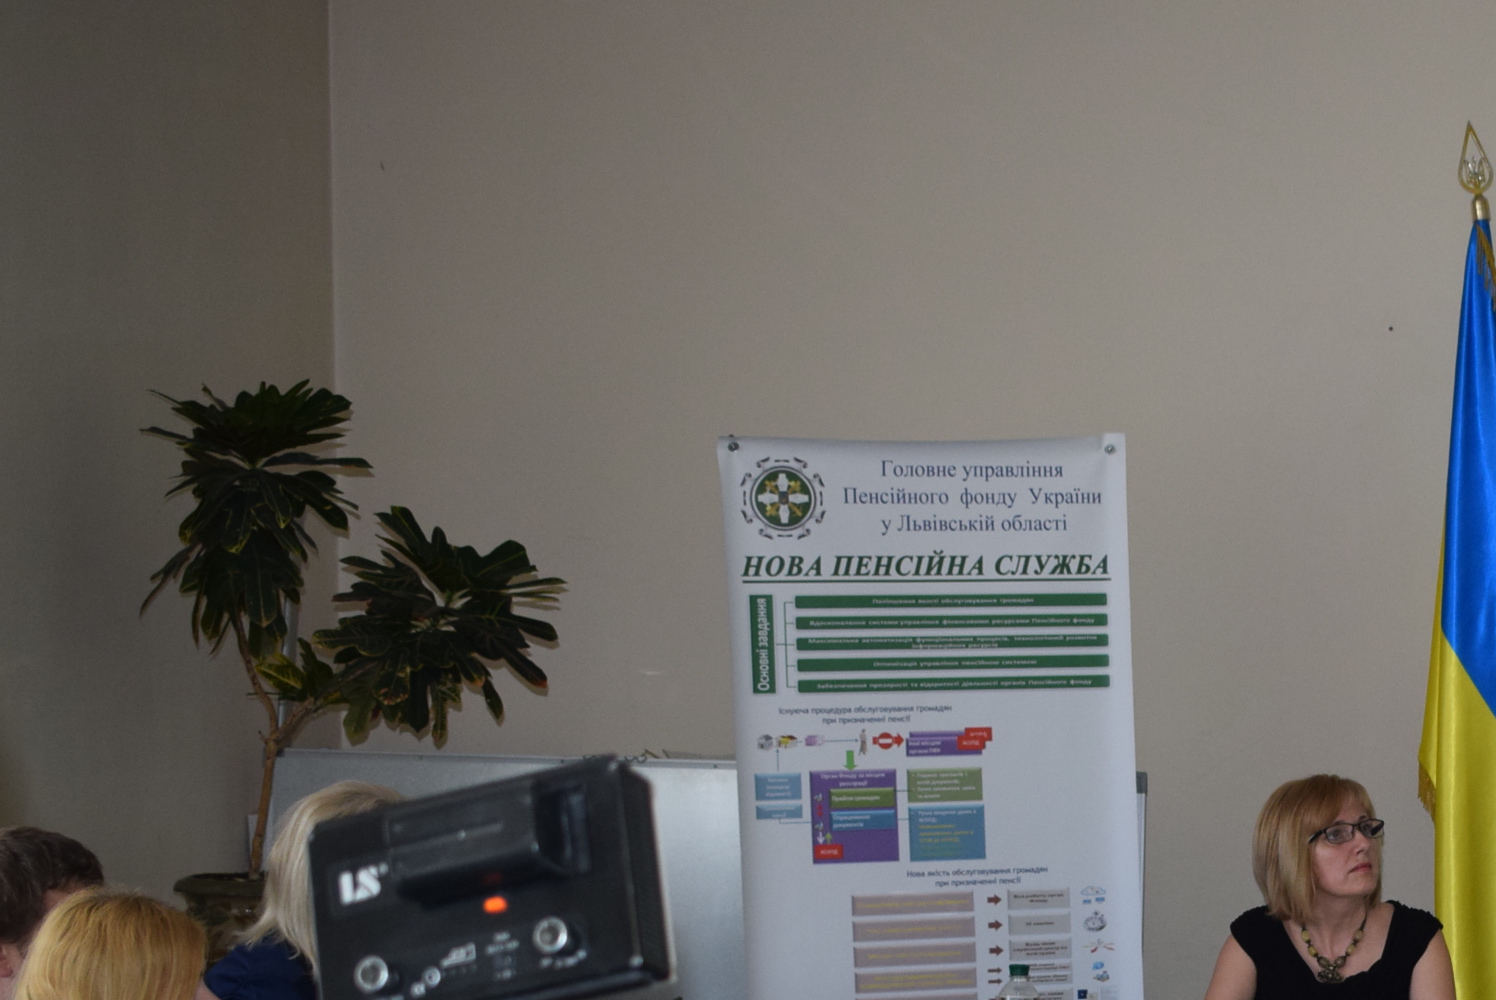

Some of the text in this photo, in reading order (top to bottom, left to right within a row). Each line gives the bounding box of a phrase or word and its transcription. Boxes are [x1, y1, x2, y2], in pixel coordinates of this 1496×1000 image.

[880, 459, 1063, 482] Головне управління
[843, 486, 1102, 509] Пенсійного фонду України
[881, 512, 1068, 535] у Львівській області
[742, 550, 1110, 578] НОВА ПЕНСІЙНА СЛУЖБА
[756, 598, 770, 691] Основні завдання
[778, 704, 952, 716] Існуюча процедура обслуговування громадян
[822, 717, 837, 725] при
[907, 866, 1048, 878] Нова якість обслуговування громадян
[935, 876, 1021, 888] при призначенні пенсії
